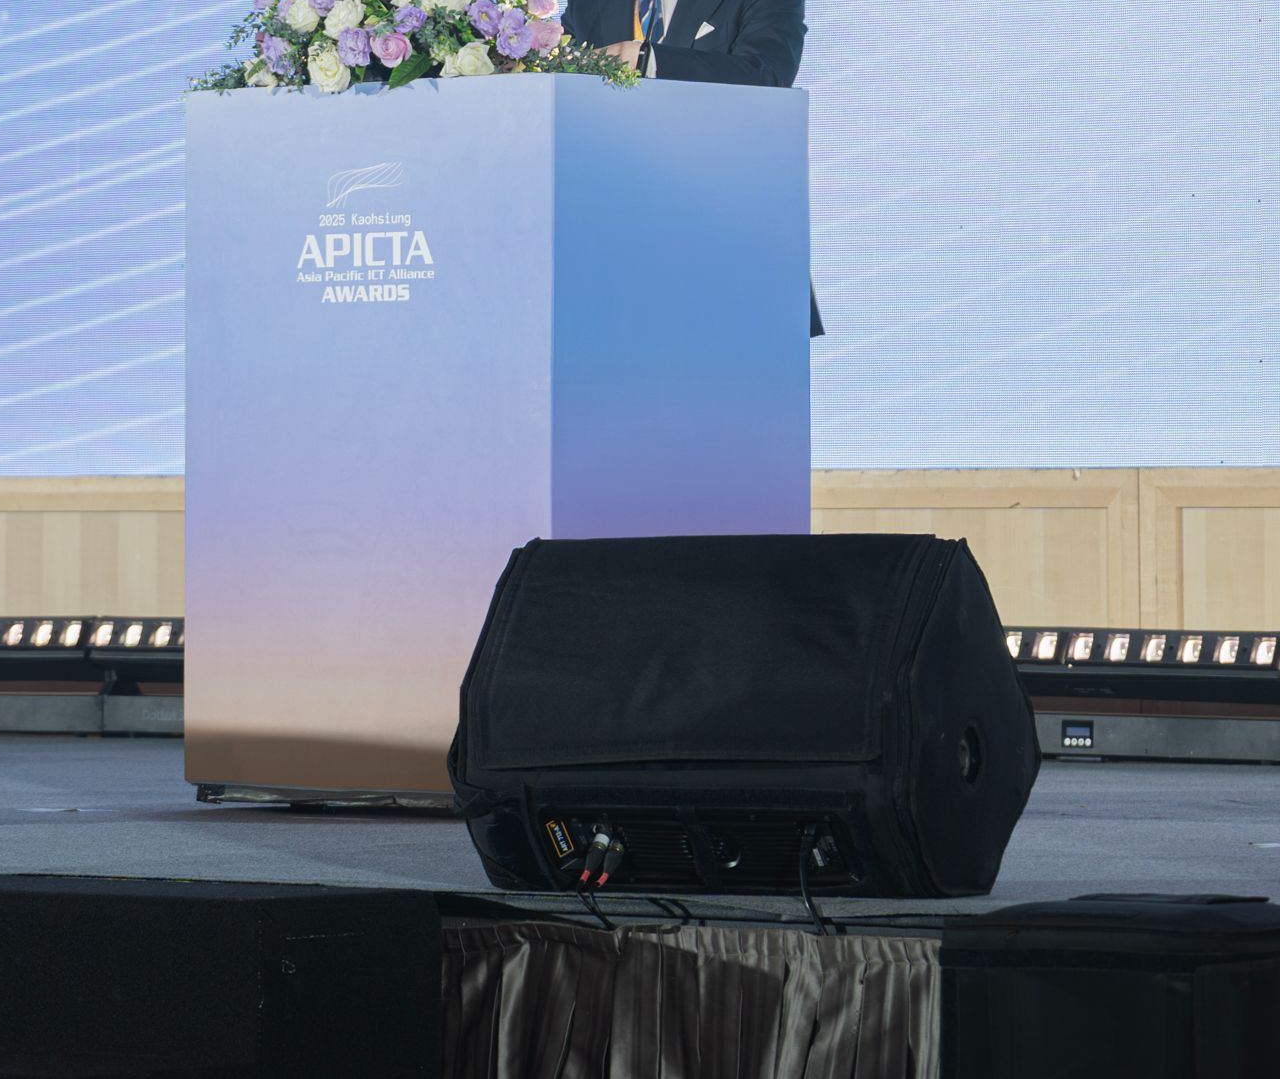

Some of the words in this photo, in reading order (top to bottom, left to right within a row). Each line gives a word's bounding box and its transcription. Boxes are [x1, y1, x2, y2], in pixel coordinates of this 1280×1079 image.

[319, 214, 346, 228] 2025
[351, 213, 412, 226] Kaohsiung
[297, 230, 434, 269] APICTA
[297, 271, 322, 283] Asia
[325, 270, 364, 282] Pacific
[368, 270, 385, 281] ICT
[388, 269, 435, 280] Alliance
[321, 284, 410, 303] AWARDS
